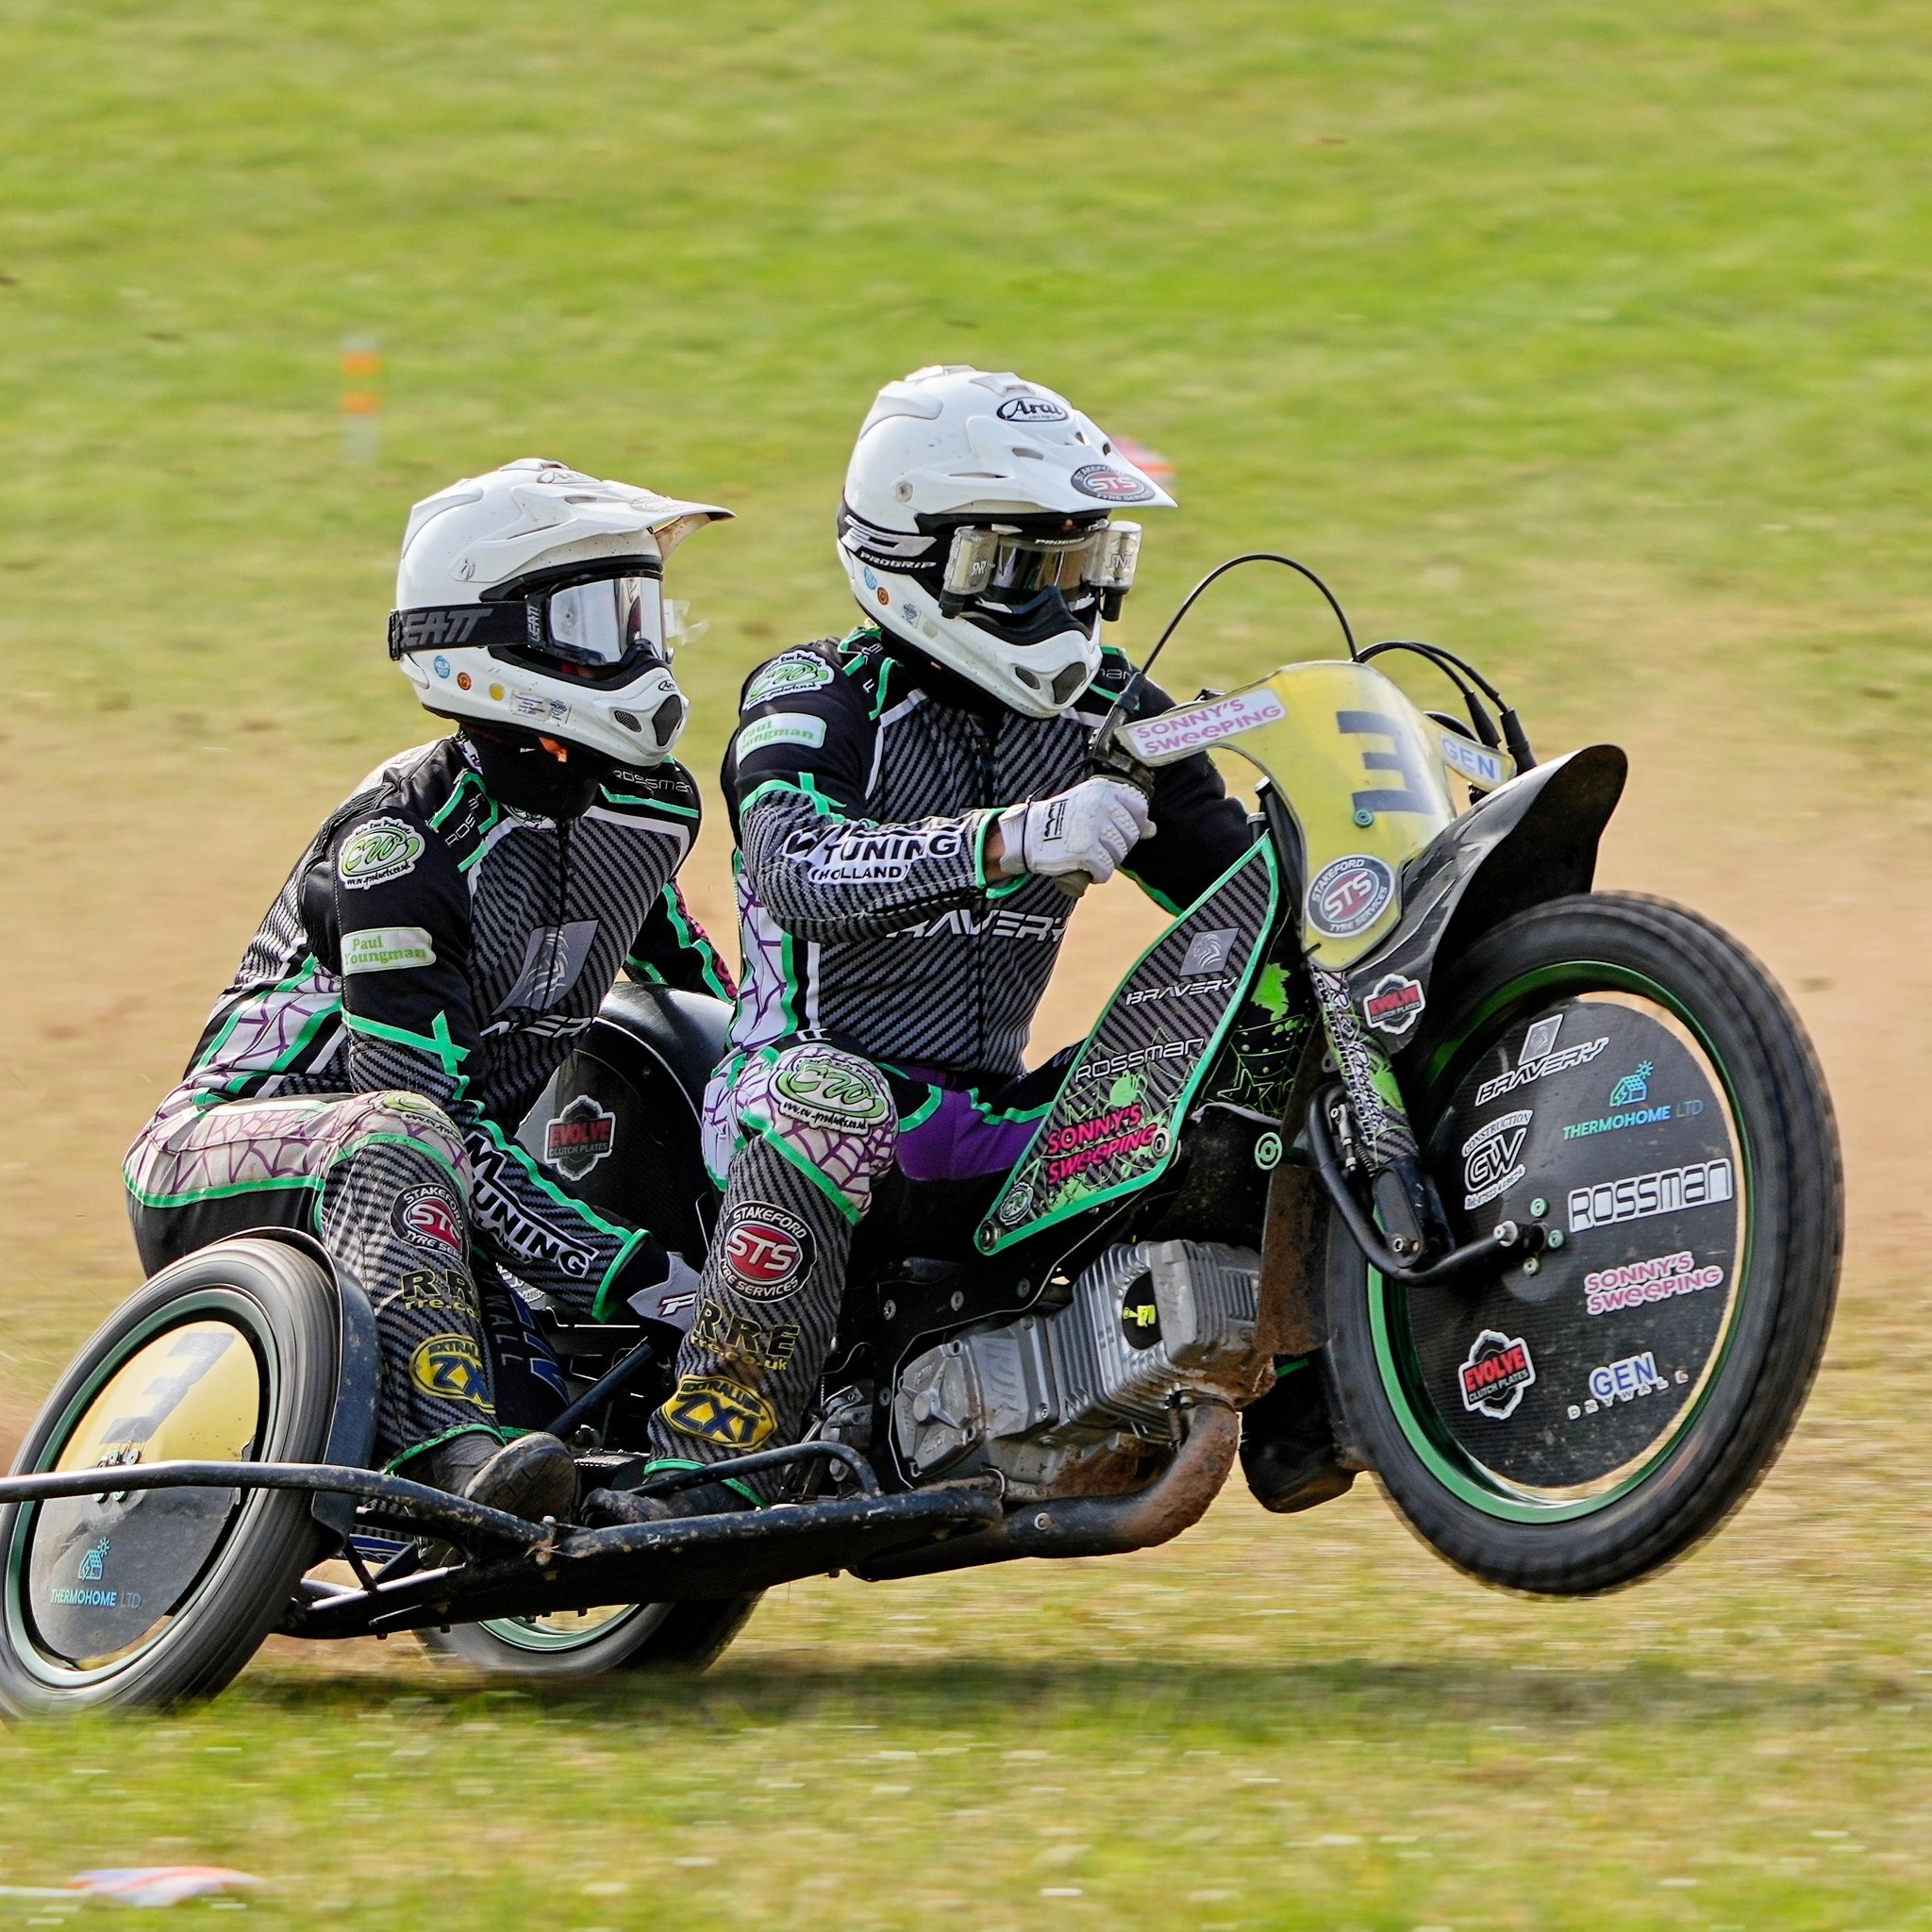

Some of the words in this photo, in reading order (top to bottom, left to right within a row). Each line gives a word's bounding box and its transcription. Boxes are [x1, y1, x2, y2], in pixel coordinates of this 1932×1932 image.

[1090, 476, 1135, 491] STS
[860, 551, 938, 569] PROGRIP
[1137, 699, 1245, 739] SONNY'S
[1336, 710, 1437, 816] 3
[1441, 738, 1496, 779] GEN
[1311, 858, 1366, 904] STAKEFORD
[1324, 871, 1373, 920] STS
[352, 935, 385, 951] Paul
[1125, 977, 1238, 1007] BRAVERY
[1476, 1039, 1608, 1106] BRAVERY
[1048, 1102, 1143, 1155] SONNY'S
[1463, 1113, 1531, 1156] CONSTRUCTION
[1563, 1105, 1672, 1141] THERMOHOME
[1676, 1099, 1704, 1118] LTD
[408, 1230, 437, 1246] TYRE
[474, 1179, 589, 1277] UNING
[733, 1206, 808, 1239] STAKEFORD
[725, 1228, 798, 1271] STS
[736, 1275, 799, 1297] SERVICES
[1588, 1254, 1691, 1291] SONNY'S
[694, 1298, 801, 1358] RRE
[430, 1356, 491, 1405] ZX
[1464, 1350, 1526, 1392] EVOLVE
[1469, 1385, 1499, 1403] CLUTCH
[1498, 1370, 1529, 1389] PLATES
[1592, 1357, 1657, 1397] GEN
[675, 1392, 759, 1443] ZX1
[51, 1589, 118, 1607] THERMOHOME
[120, 1591, 142, 1609] LTD
